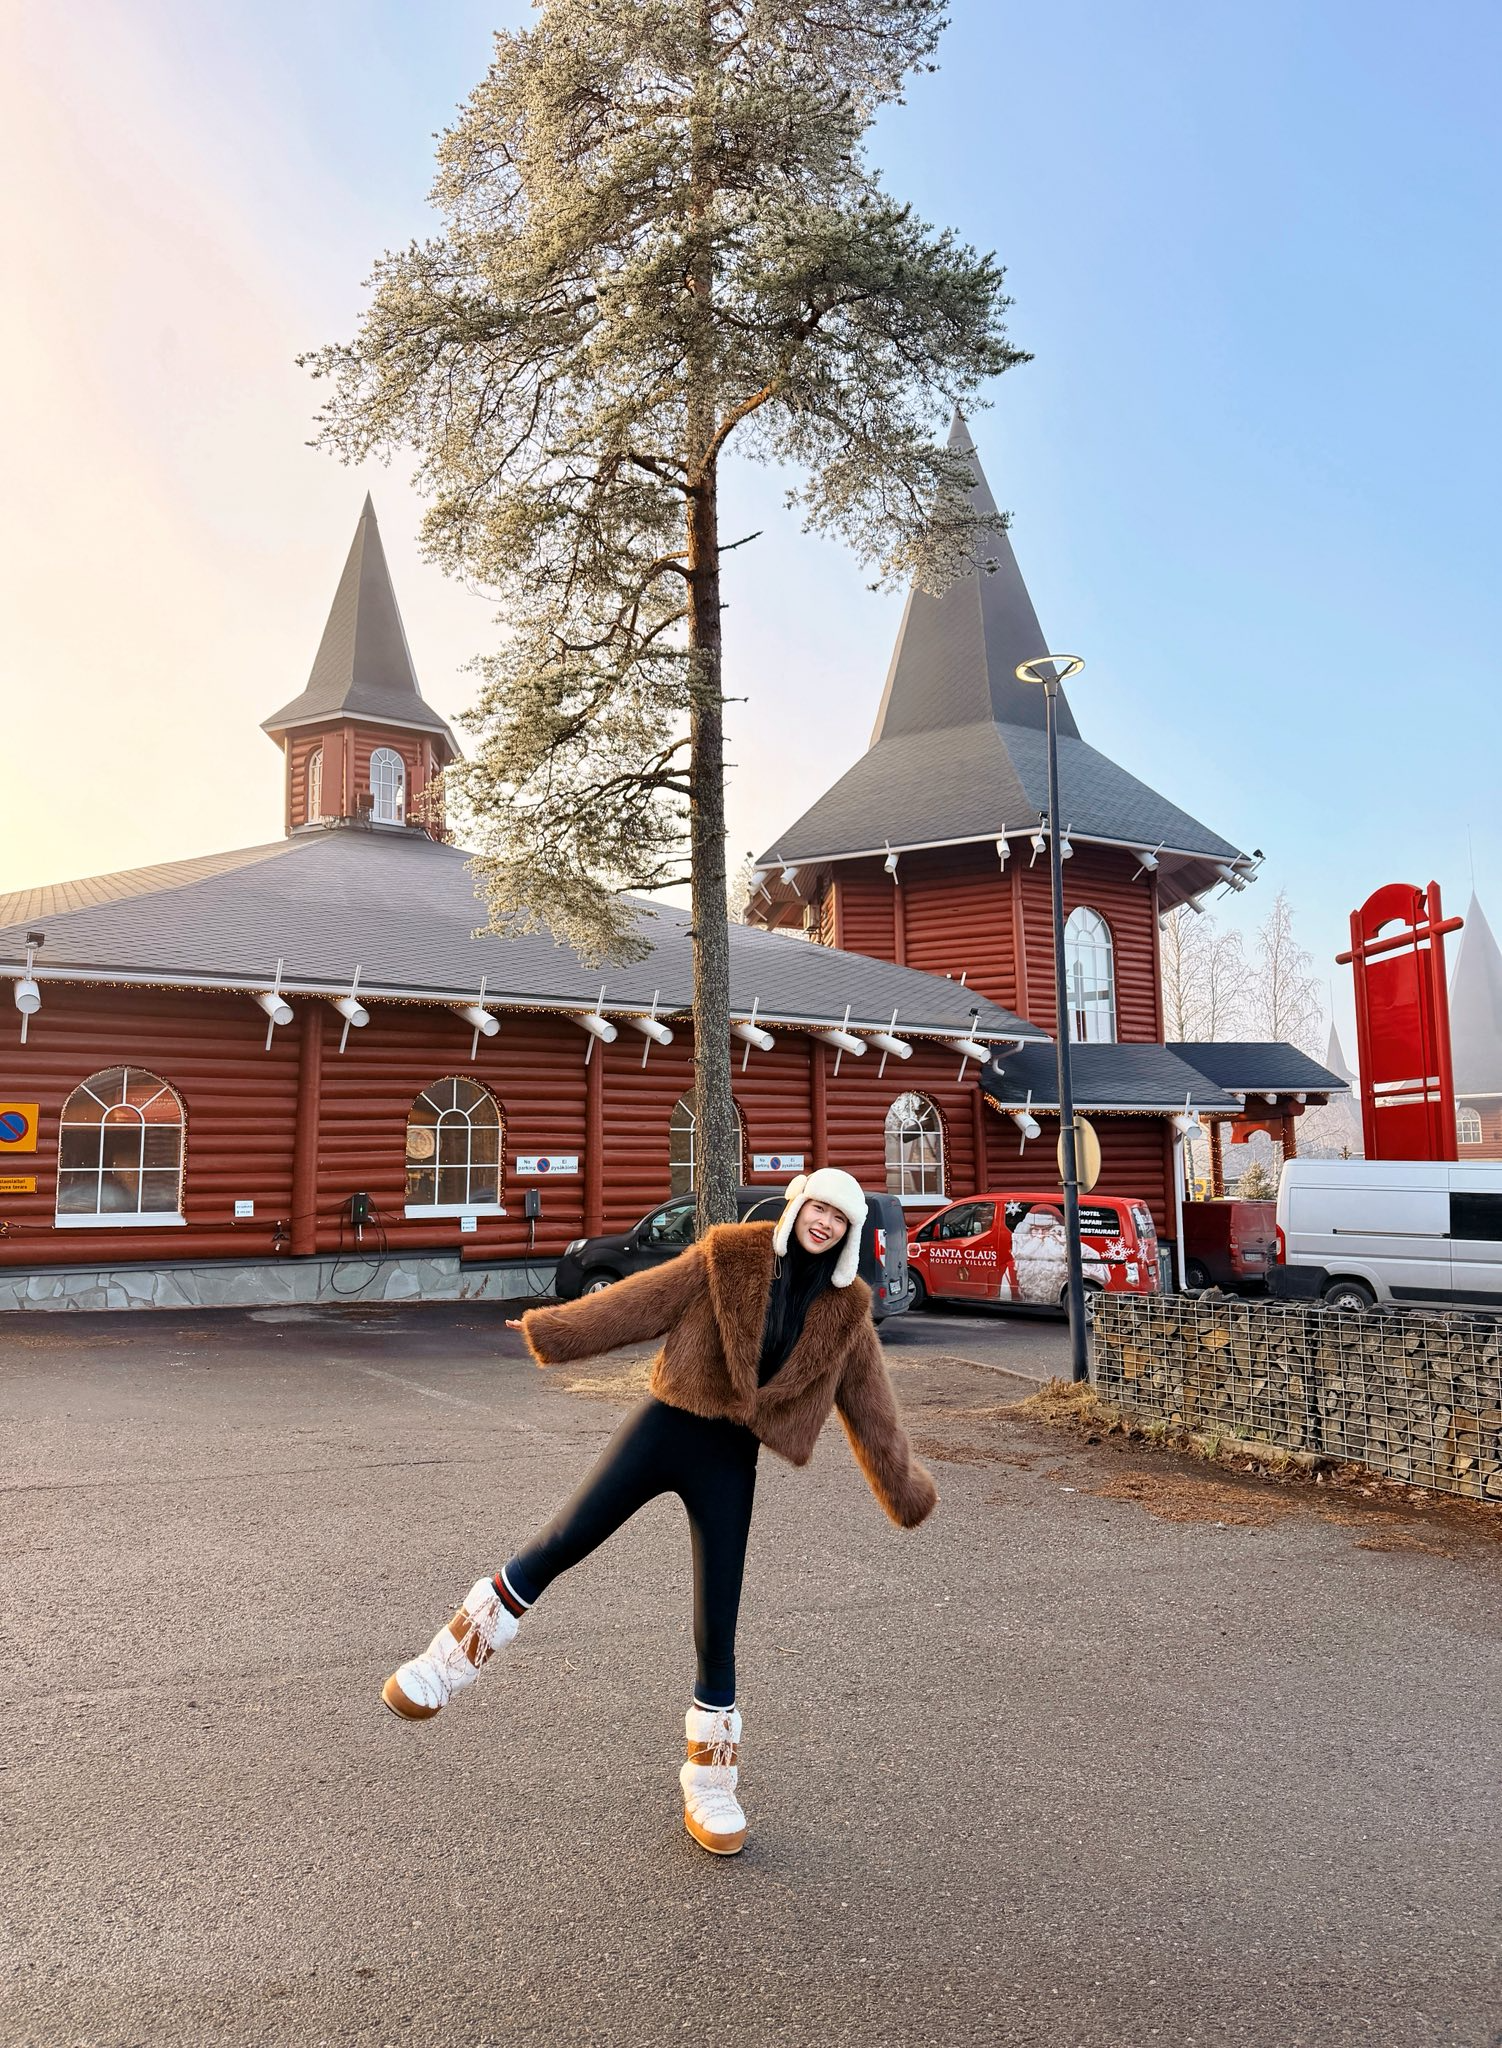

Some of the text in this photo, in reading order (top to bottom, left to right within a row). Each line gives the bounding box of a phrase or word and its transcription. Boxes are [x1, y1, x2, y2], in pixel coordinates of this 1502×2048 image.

[1080, 1227, 1120, 1235] RESTAURANT
[929, 1247, 997, 1260] SANTA CLAUS
